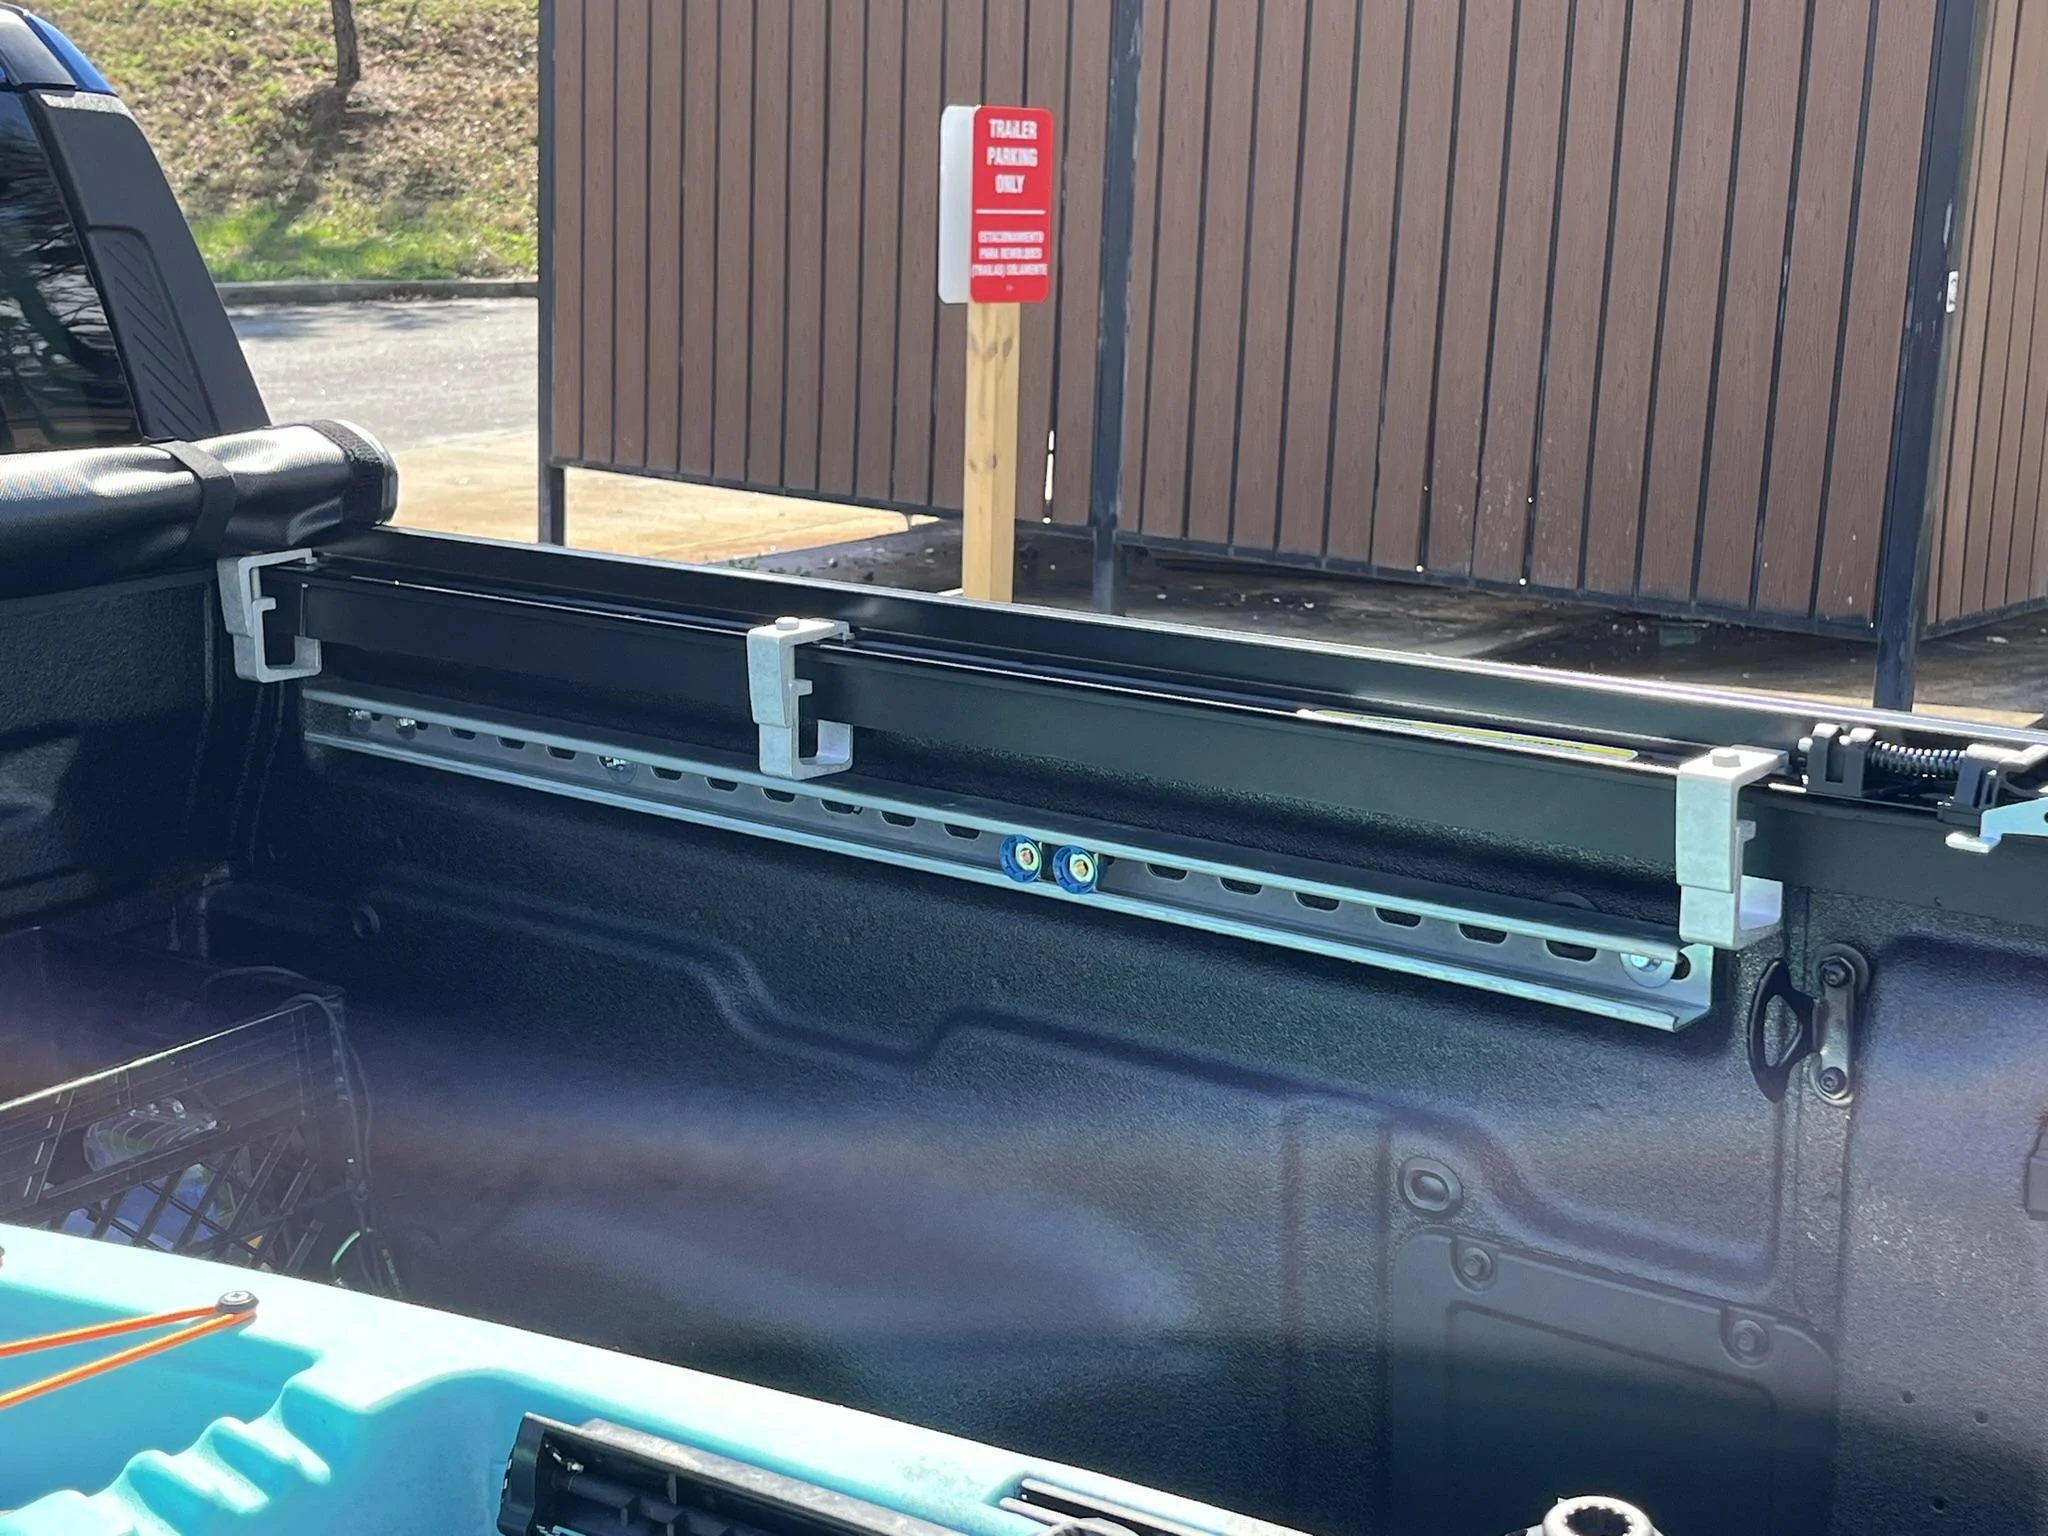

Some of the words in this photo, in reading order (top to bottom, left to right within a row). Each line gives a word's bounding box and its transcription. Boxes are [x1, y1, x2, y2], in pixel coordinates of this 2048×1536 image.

[989, 119, 1037, 140] TRAILER
[986, 147, 1038, 167] PARKING
[995, 174, 1025, 194] ONLY
